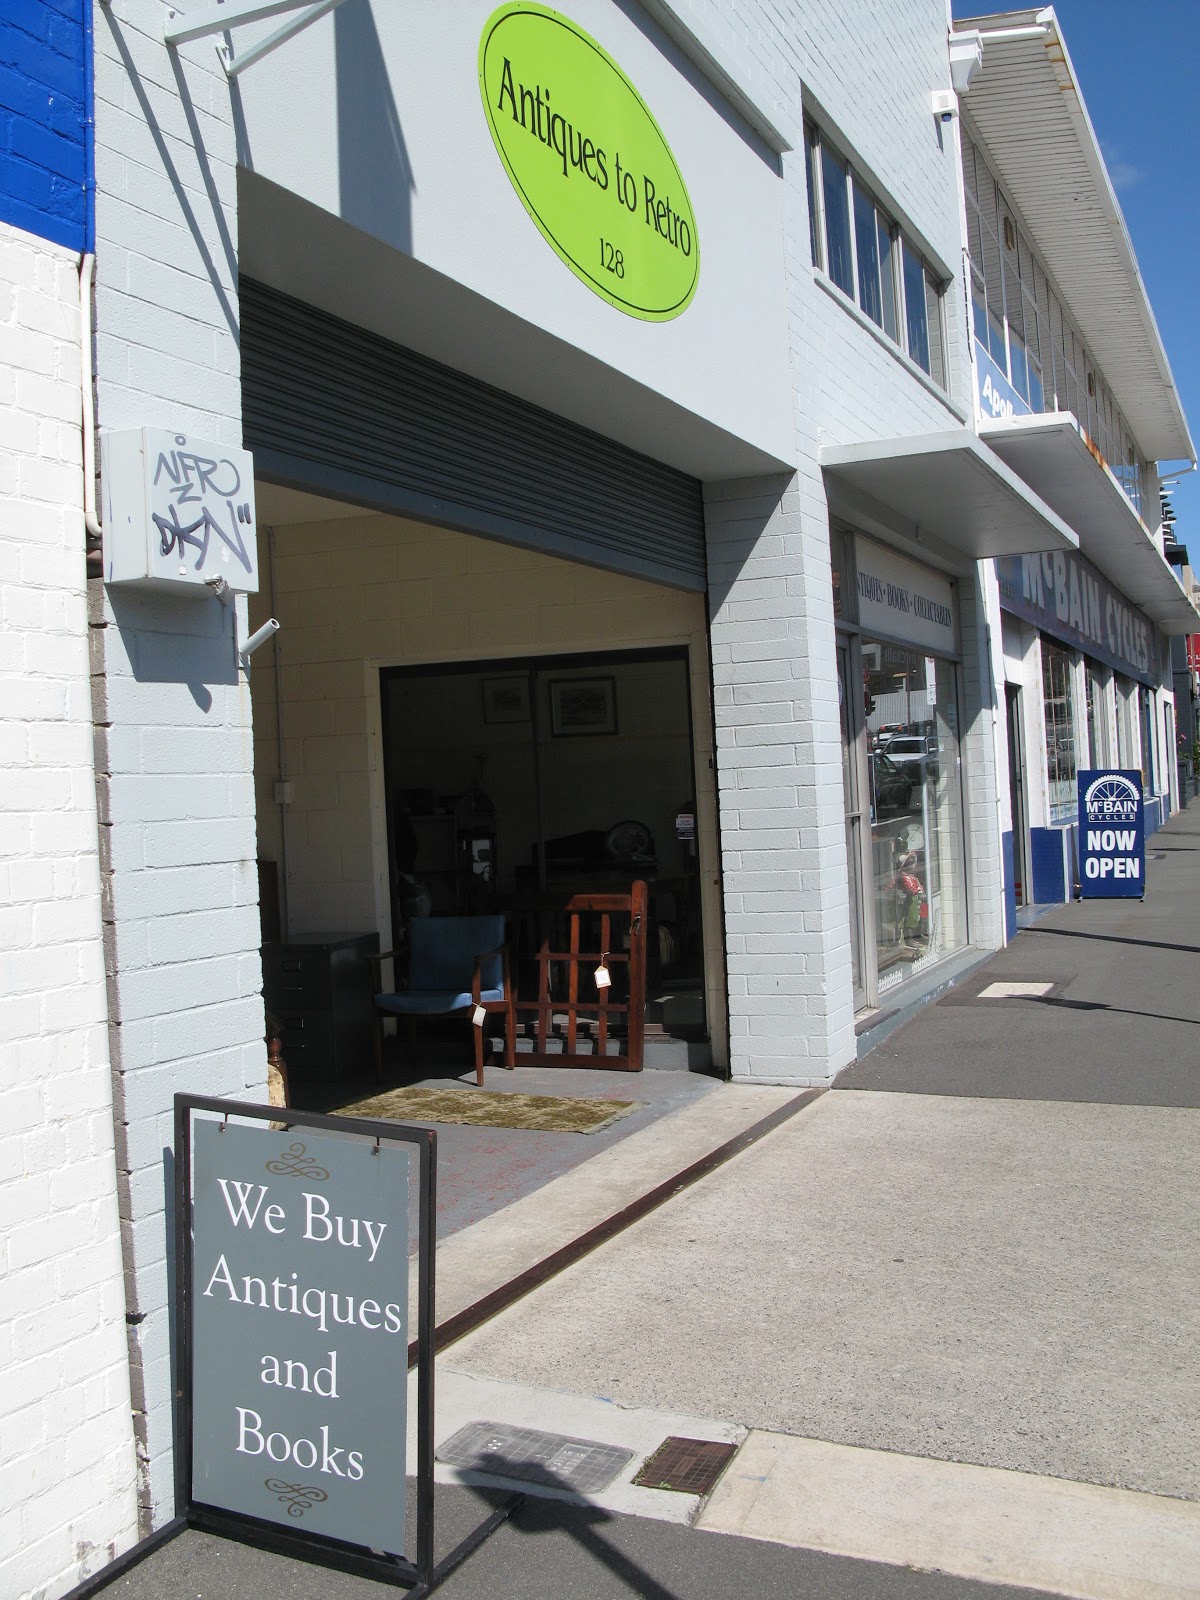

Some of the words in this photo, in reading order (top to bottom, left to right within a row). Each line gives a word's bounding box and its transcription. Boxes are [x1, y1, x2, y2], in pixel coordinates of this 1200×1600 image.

[497, 56, 609, 191] Antiques
[615, 152, 637, 213] to
[643, 174, 691, 257] Retro
[599, 237, 625, 279] 128
[982, 373, 1018, 418] Apoll
[887, 583, 910, 613] BOOKS
[1106, 592, 1149, 674] CYCLES
[1087, 830, 1136, 851] NOW
[1085, 857, 1140, 879] OPEN
[217, 1178, 286, 1235] We
[301, 1192, 388, 1262] Buy
[203, 1253, 402, 1333] Antiques
[260, 1350, 340, 1399] and
[235, 1406, 364, 1481] Books
